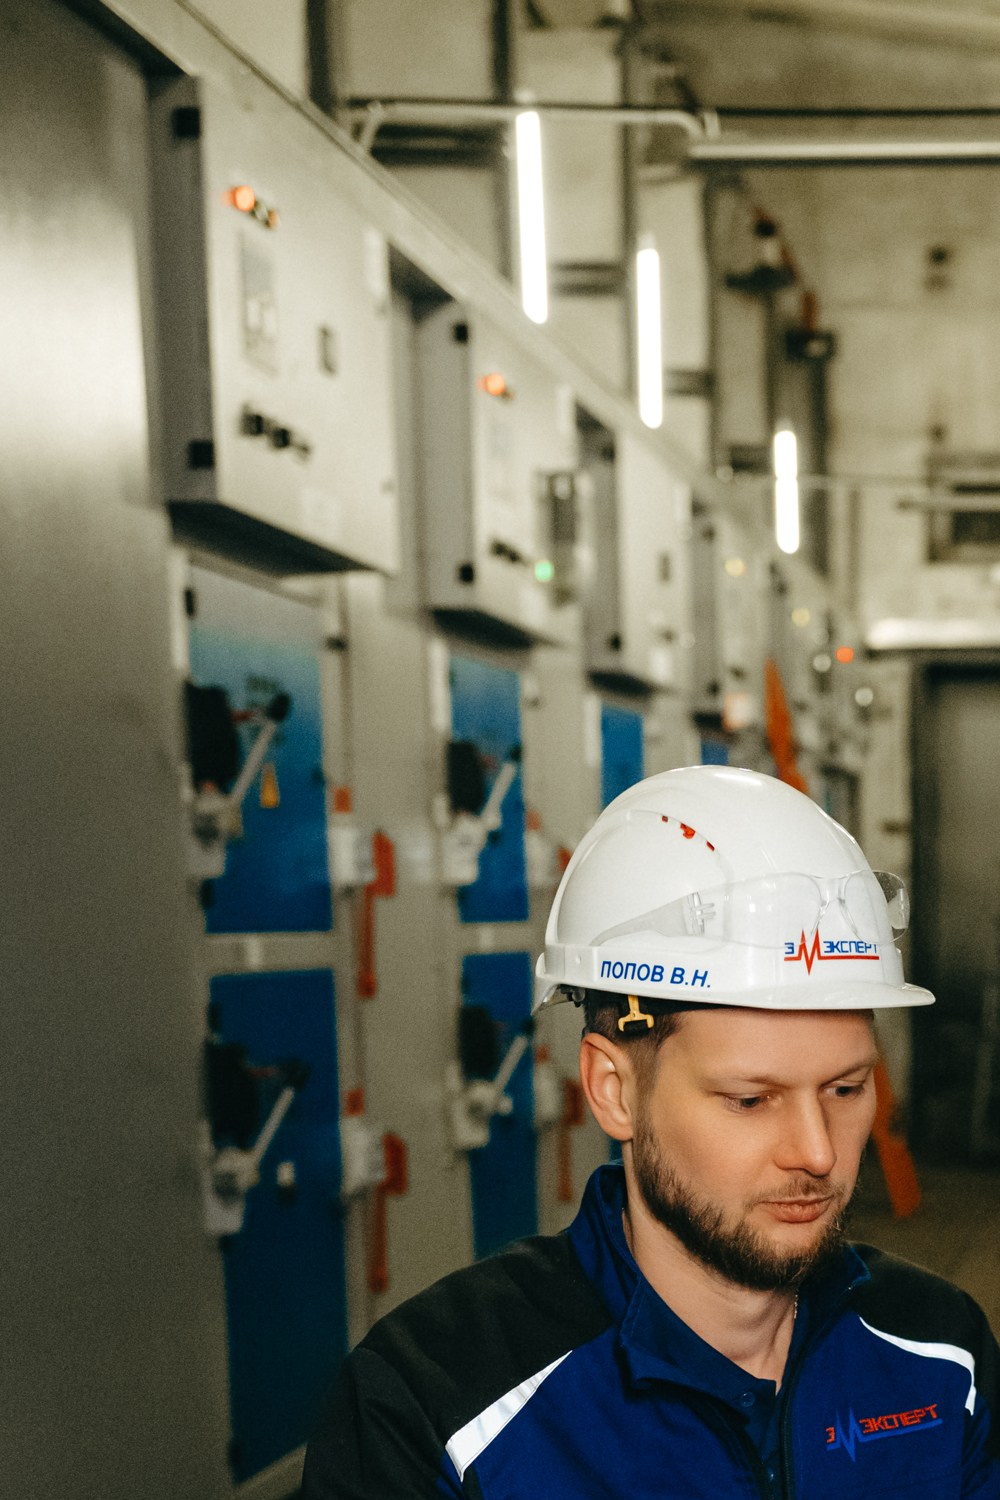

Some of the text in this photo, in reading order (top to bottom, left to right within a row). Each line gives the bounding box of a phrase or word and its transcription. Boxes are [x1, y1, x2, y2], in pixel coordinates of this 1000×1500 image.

[600, 960, 711, 989] ПОПОВ В.Н.
[859, 1403, 937, 1433] ЭКСПЕРТ
